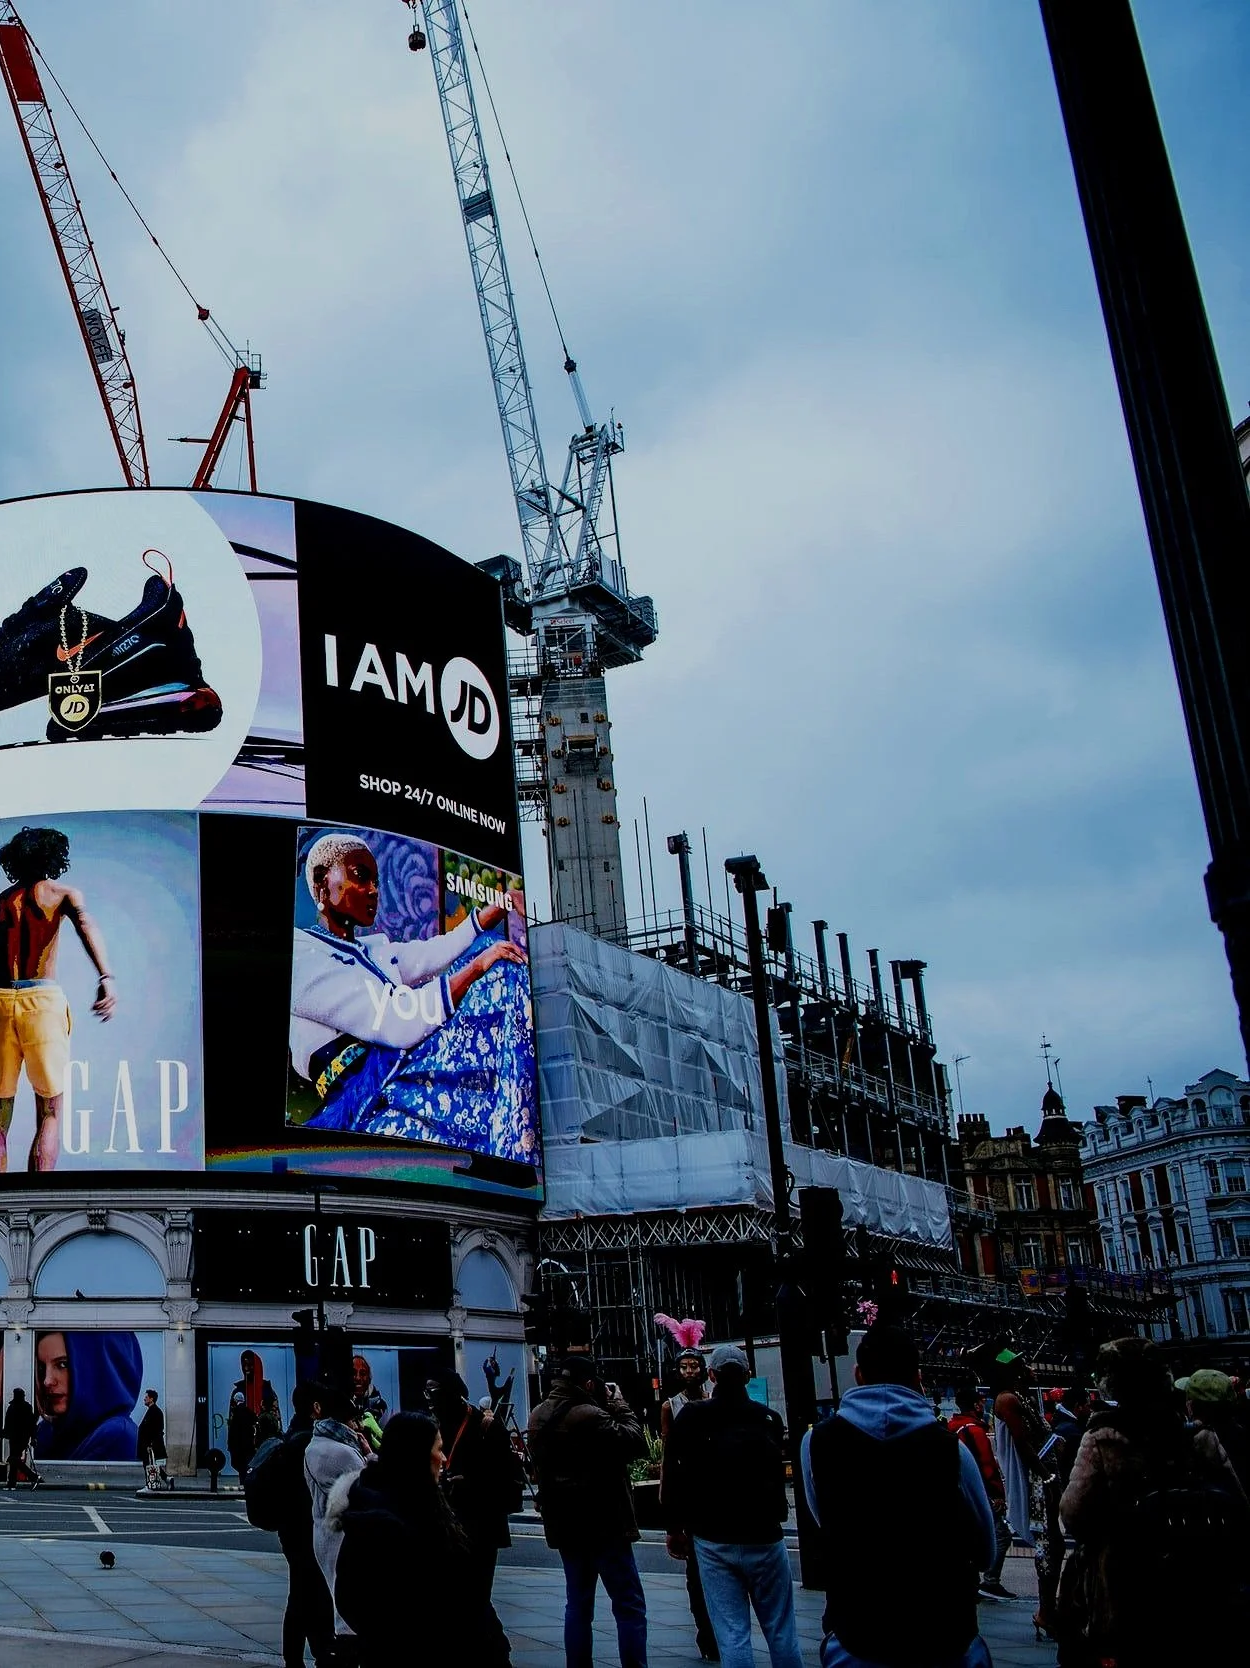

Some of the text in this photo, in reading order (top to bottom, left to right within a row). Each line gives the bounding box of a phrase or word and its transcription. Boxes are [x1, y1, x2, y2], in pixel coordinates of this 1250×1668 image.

[84, 312, 112, 361] WOLFF
[324, 633, 339, 687] I
[350, 642, 436, 715] AM
[64, 701, 86, 714] JD
[359, 773, 506, 835] SHOP 24/7 ONLINE NOW
[445, 872, 513, 912] SAMSUNG
[364, 978, 442, 1032] you
[62, 1059, 189, 1155] GAP
[303, 1223, 377, 1289] GAP
